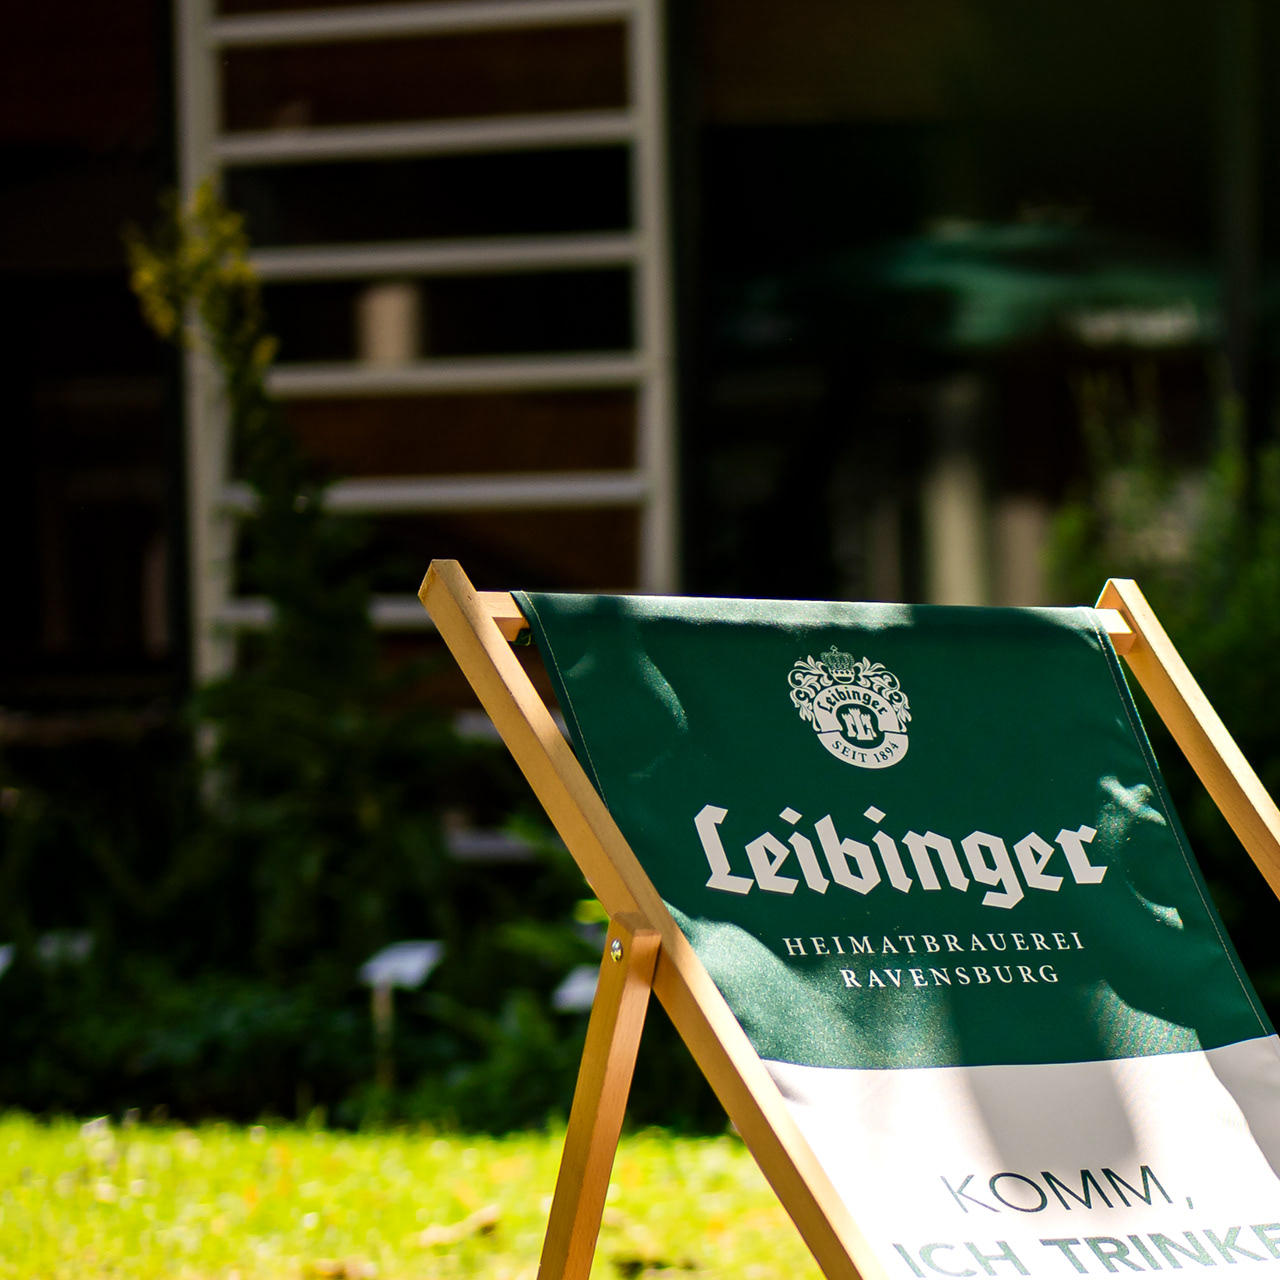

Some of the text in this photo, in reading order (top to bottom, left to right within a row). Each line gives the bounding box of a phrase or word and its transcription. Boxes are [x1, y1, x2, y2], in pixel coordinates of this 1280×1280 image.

[816, 686, 889, 716] Leibinger
[831, 740, 899, 763] SEIT 1894
[693, 804, 1108, 909] Leibinger
[782, 931, 1085, 957] HEIMATBRAUEREI
[839, 964, 1060, 989] RAVENSBURG
[940, 1165, 1195, 1214] KOMM,
[892, 1239, 1032, 1279] ICH
